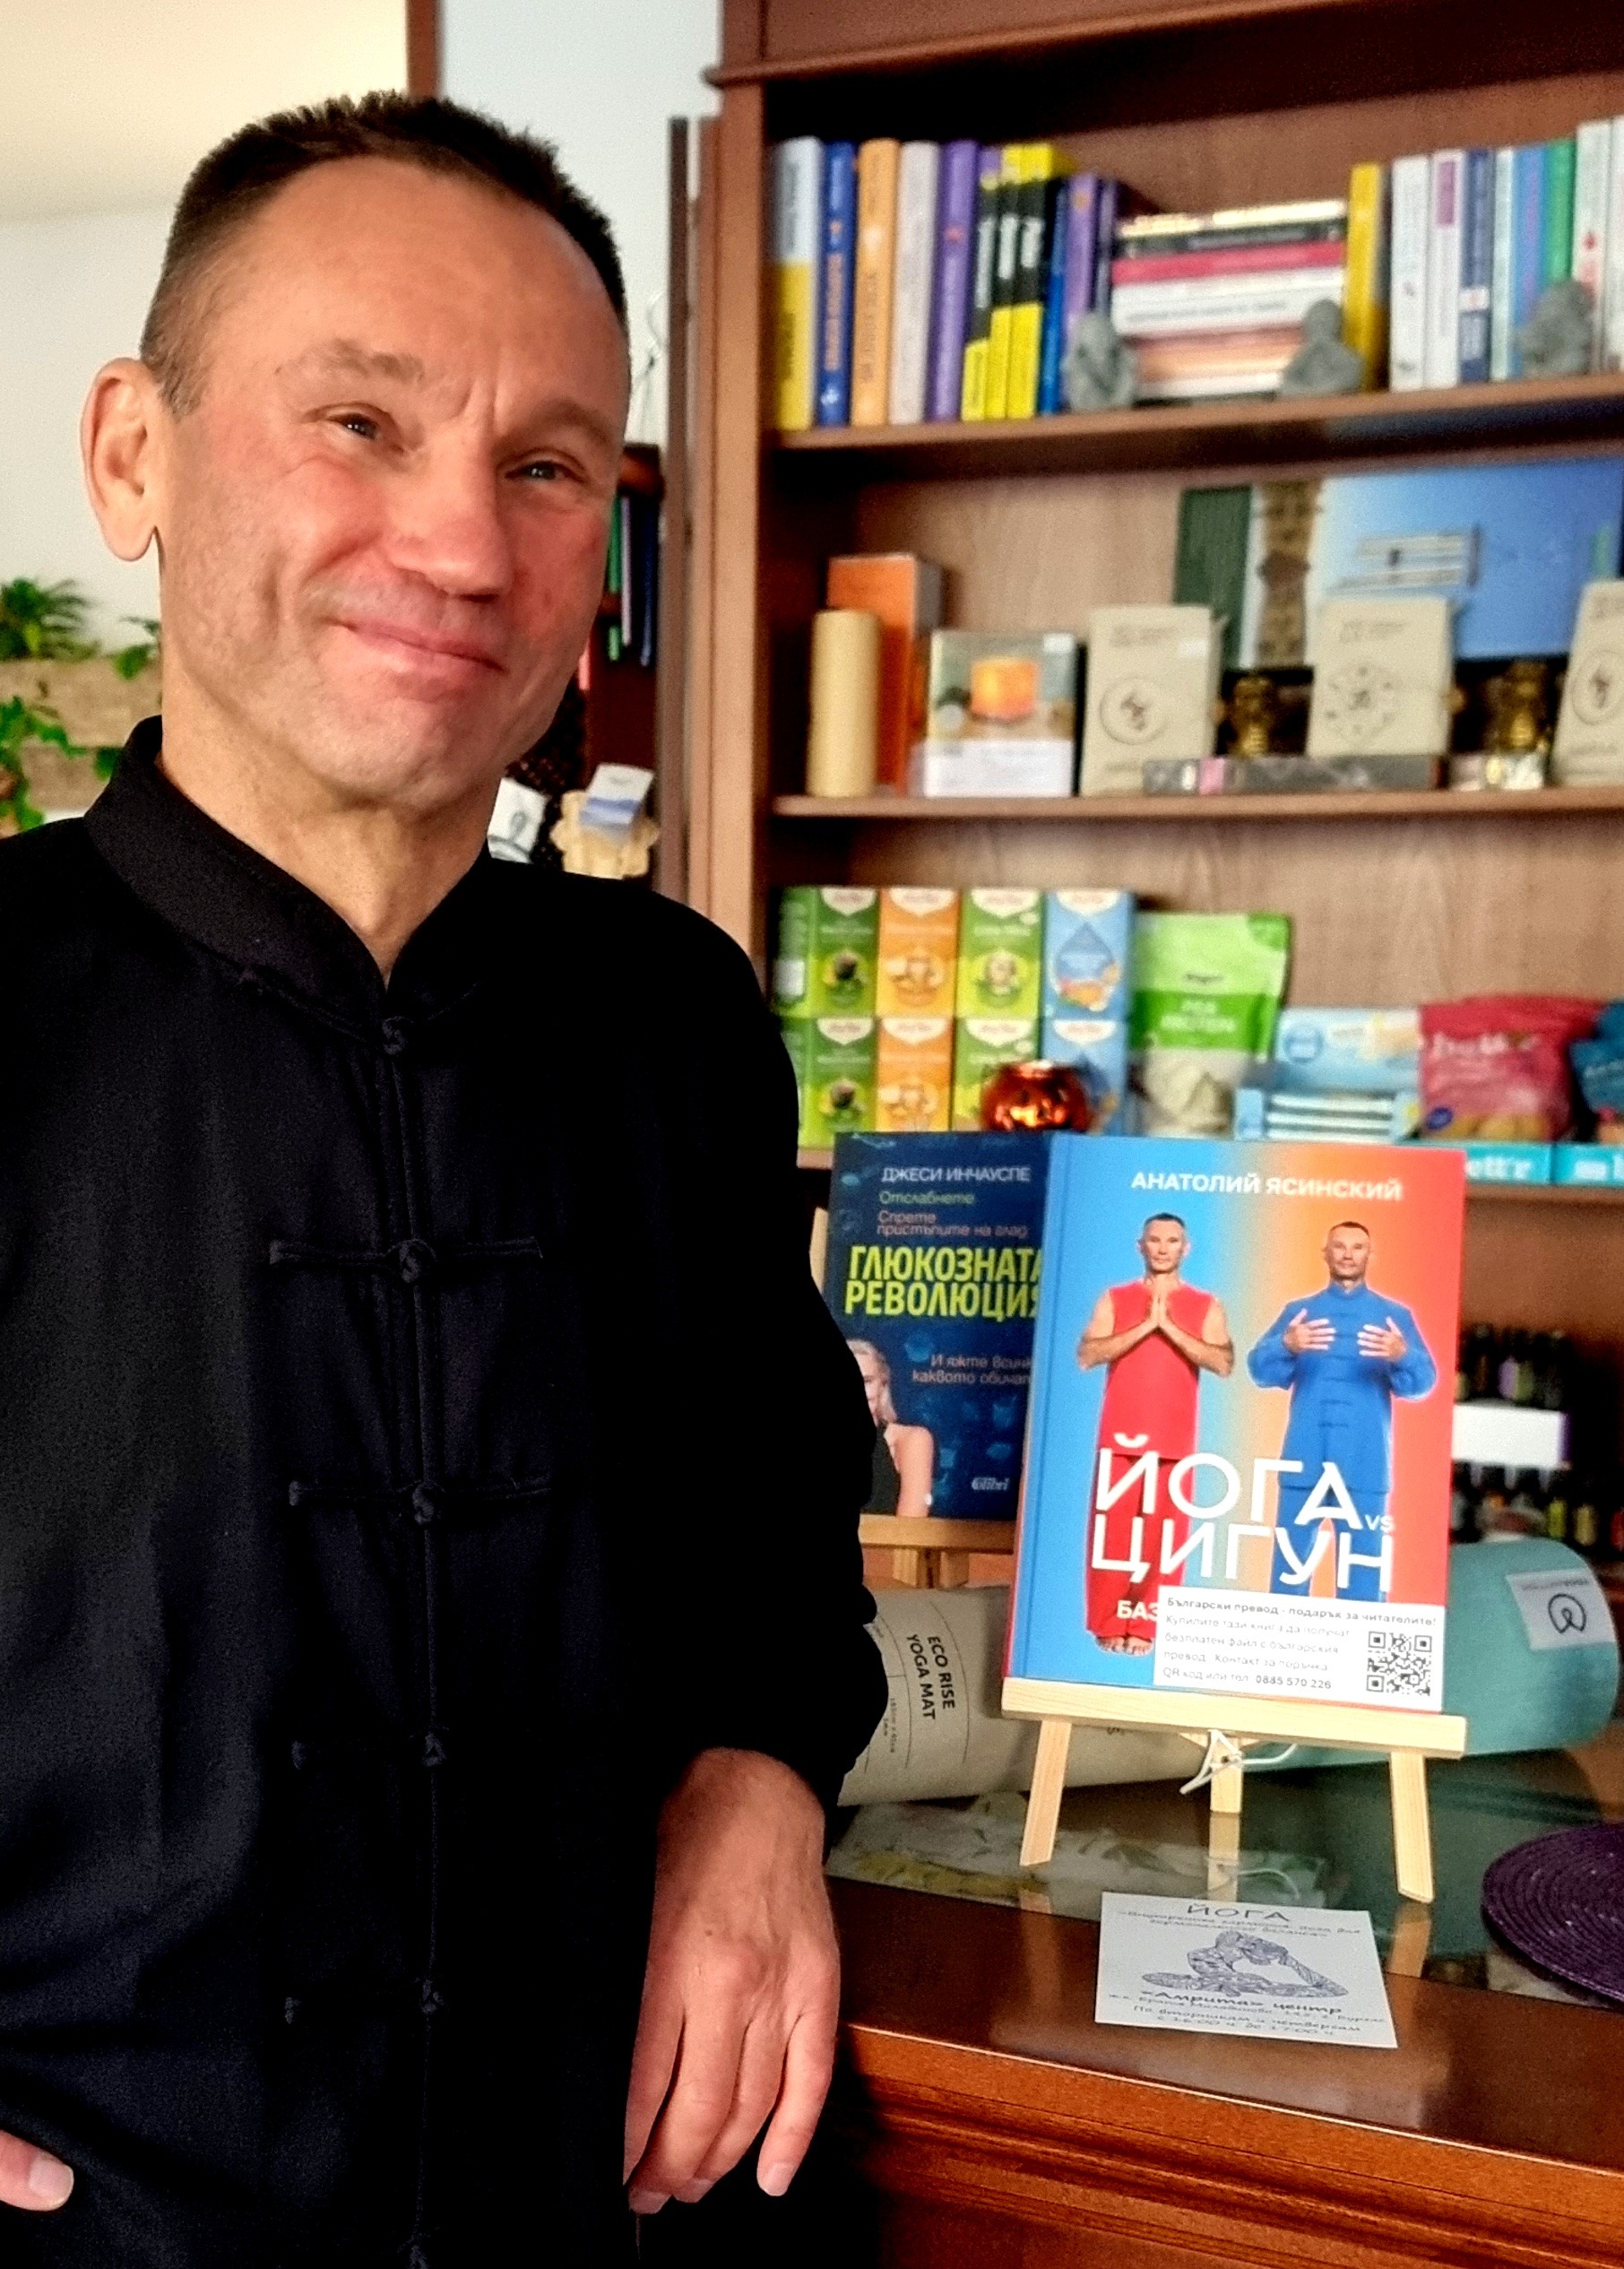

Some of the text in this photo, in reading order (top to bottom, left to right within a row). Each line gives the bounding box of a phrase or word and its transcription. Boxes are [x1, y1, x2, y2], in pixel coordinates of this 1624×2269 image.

[881, 1166, 1032, 1182] ДЖЕСИ ИНЧАУСПЕ
[1131, 1172, 1404, 1202] АНАТОЛИЙ ЯСИНСКИЙ
[878, 1191, 975, 1204] Отслабнете
[878, 1210, 937, 1225] Спрете
[877, 1224, 971, 1238] пристъпите
[973, 1226, 992, 1236] на
[931, 1355, 944, 1366] И
[912, 1370, 975, 1385] каквото
[1095, 1433, 1363, 1529] ЙОГА
[1091, 1514, 1393, 1592] ЦИГУН
[1168, 1598, 1231, 1610] Български
[1234, 1604, 1279, 1615] превод
[1289, 1608, 1341, 1618] подарък
[1362, 1615, 1436, 1626] читателите!
[1166, 1615, 1219, 1626] Купилите
[1165, 1632, 1224, 1644] безплатен
[907, 1634, 936, 1719] YOGA MAT
[927, 1636, 955, 1710] ECO RISE
[1163, 1667, 1179, 1678] QR
[1183, 1672, 1203, 1680] код
[1287, 1677, 1307, 1686] 570
[1311, 1679, 1331, 1689] 226
[1188, 1903, 1290, 1922] ЙОГА
[1273, 2003, 1342, 2014] центр
